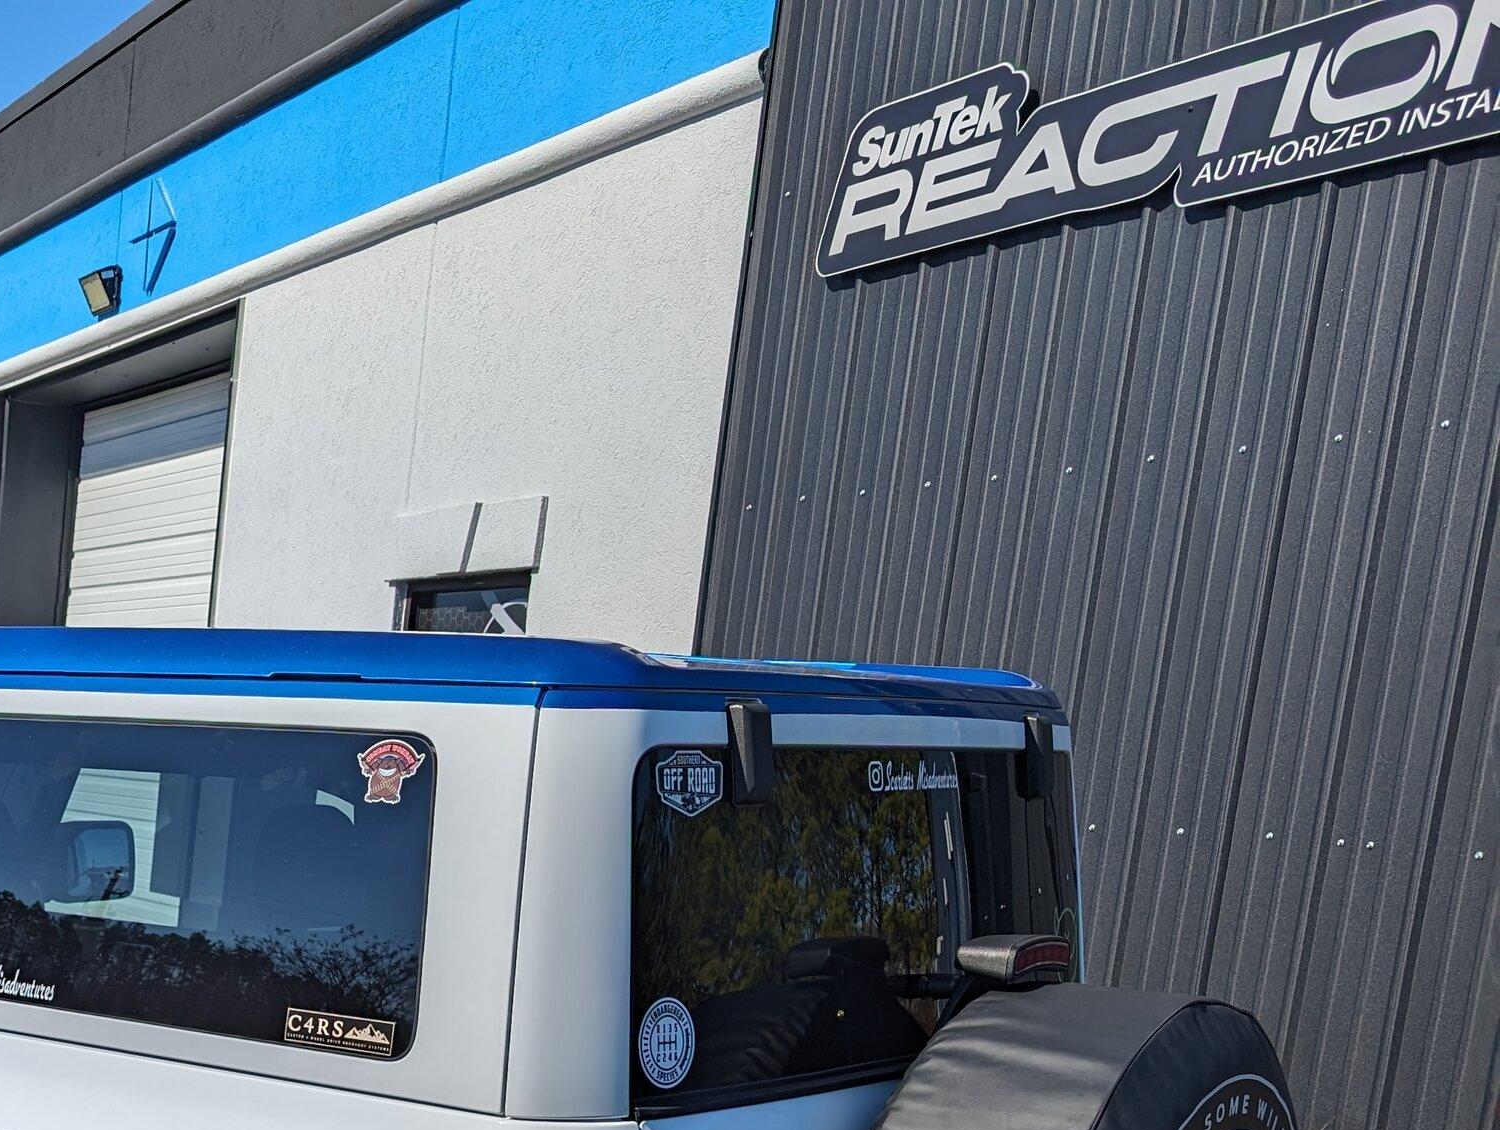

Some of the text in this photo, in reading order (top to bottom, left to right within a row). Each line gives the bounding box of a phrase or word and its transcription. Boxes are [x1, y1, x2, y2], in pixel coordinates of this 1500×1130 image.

[852, 85, 1012, 177] SunTek
[1191, 116, 1392, 188] AUTHORIZED
[663, 767, 716, 794] OFF ROAD
[287, 1014, 344, 1038] C4RS
